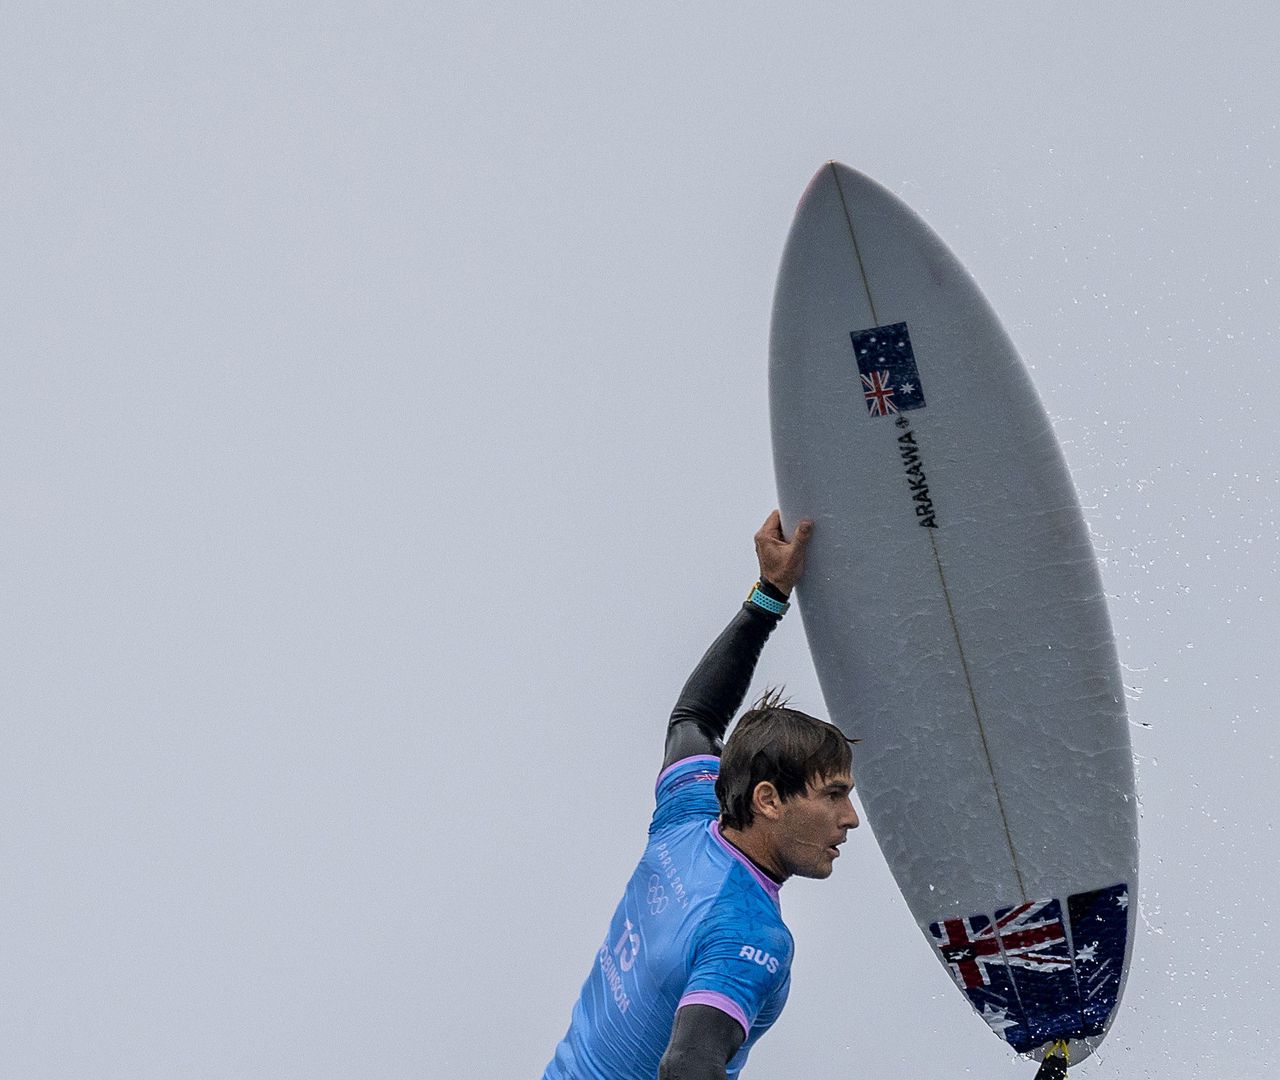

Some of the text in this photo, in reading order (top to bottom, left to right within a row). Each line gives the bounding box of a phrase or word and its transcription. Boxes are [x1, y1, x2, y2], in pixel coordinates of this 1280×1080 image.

[897, 430, 939, 529] ARAKAWA
[656, 842, 689, 910] PARIS 2024
[599, 944, 631, 1014] OBINSON
[613, 919, 641, 973] 13
[739, 945, 780, 974] AUS
